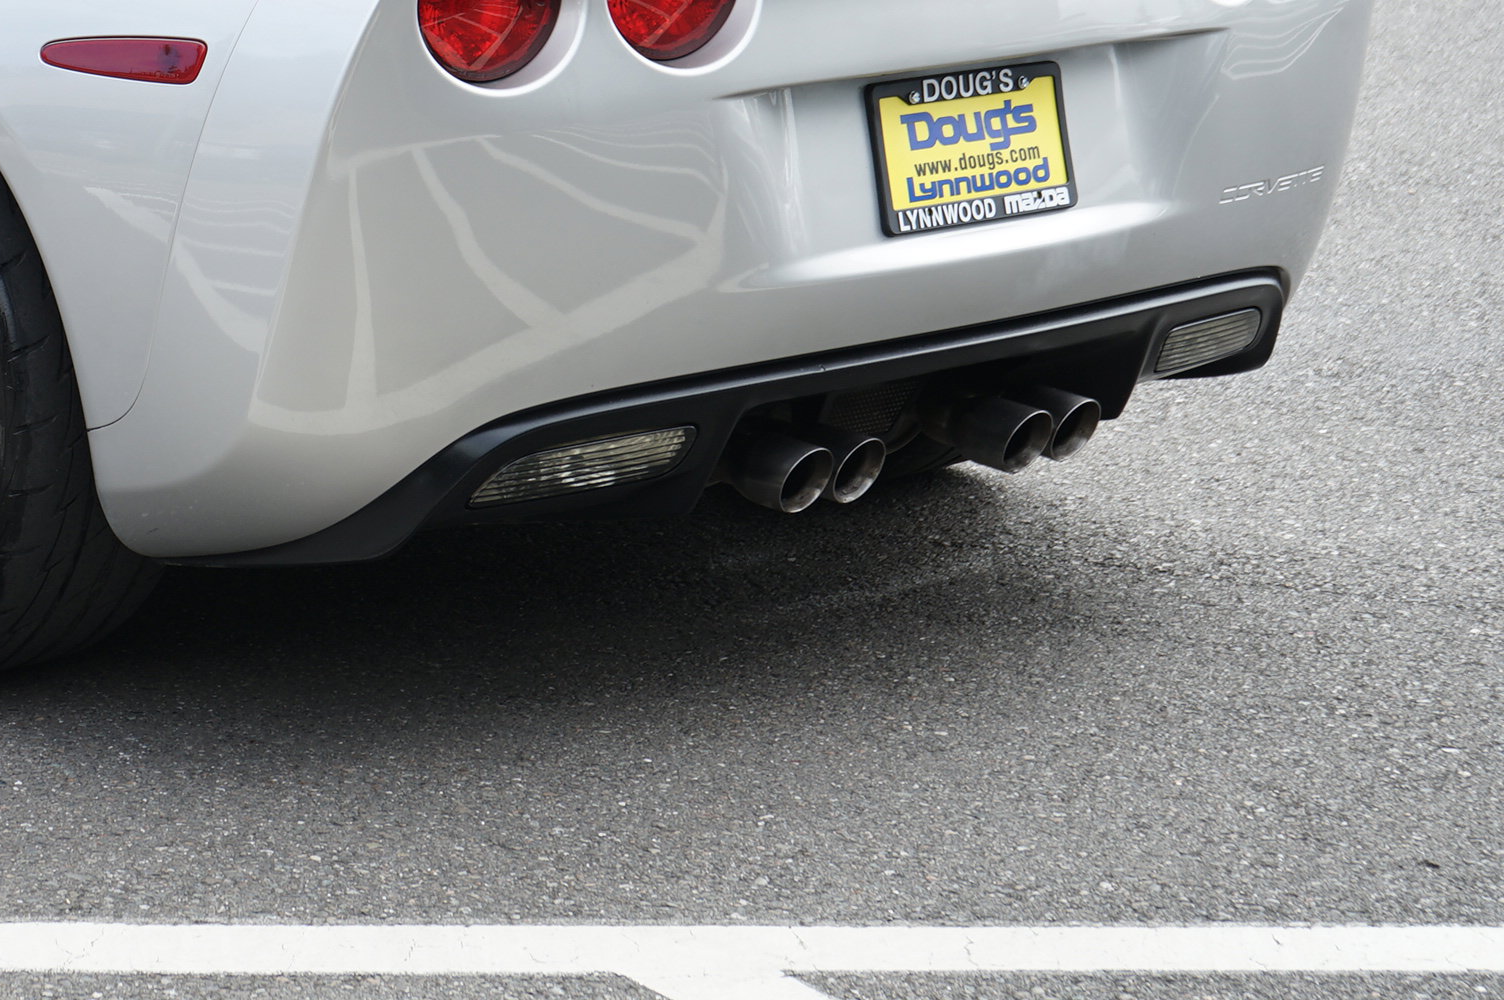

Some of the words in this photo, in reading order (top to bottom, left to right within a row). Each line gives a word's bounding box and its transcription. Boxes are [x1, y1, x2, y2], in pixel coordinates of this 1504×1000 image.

[922, 68, 1014, 103] DOUG'S
[900, 99, 1037, 151] Doug's
[914, 146, 1041, 177] www.dougs.com
[906, 157, 1051, 203] Lynnwood
[898, 198, 997, 232] LYNNWOOD
